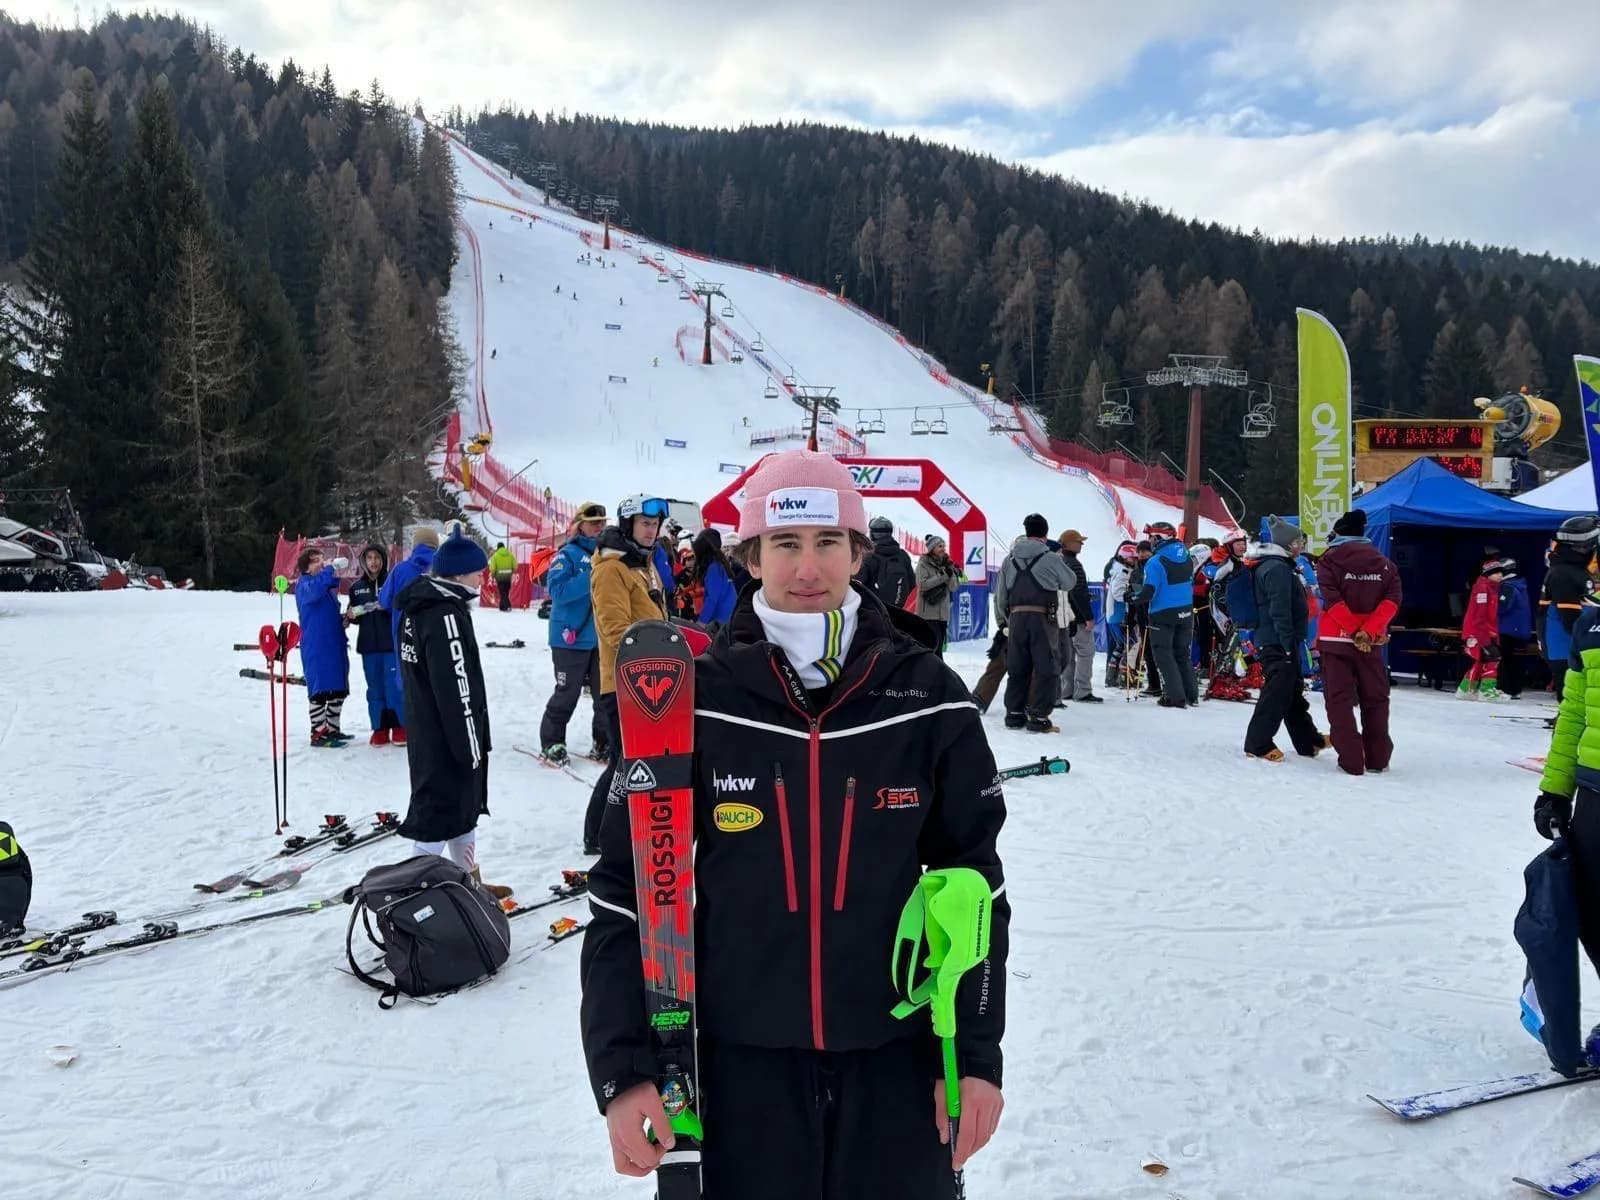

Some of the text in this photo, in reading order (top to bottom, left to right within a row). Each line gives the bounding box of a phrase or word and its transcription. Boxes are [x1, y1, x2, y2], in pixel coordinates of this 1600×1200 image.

[848, 467, 884, 484] SKI
[1307, 402, 1344, 554] TRENTINO
[778, 498, 807, 510] vkw
[1344, 572, 1382, 581] ATOMIC
[629, 663, 677, 674] ROSSIGNOL
[451, 640, 471, 717] HEAD
[719, 774, 756, 791] vkw
[887, 792, 919, 804] SKI
[719, 811, 754, 824] RAUCH
[979, 958, 991, 1015] GIRARDELLI
[651, 1011, 690, 1026] HERO
